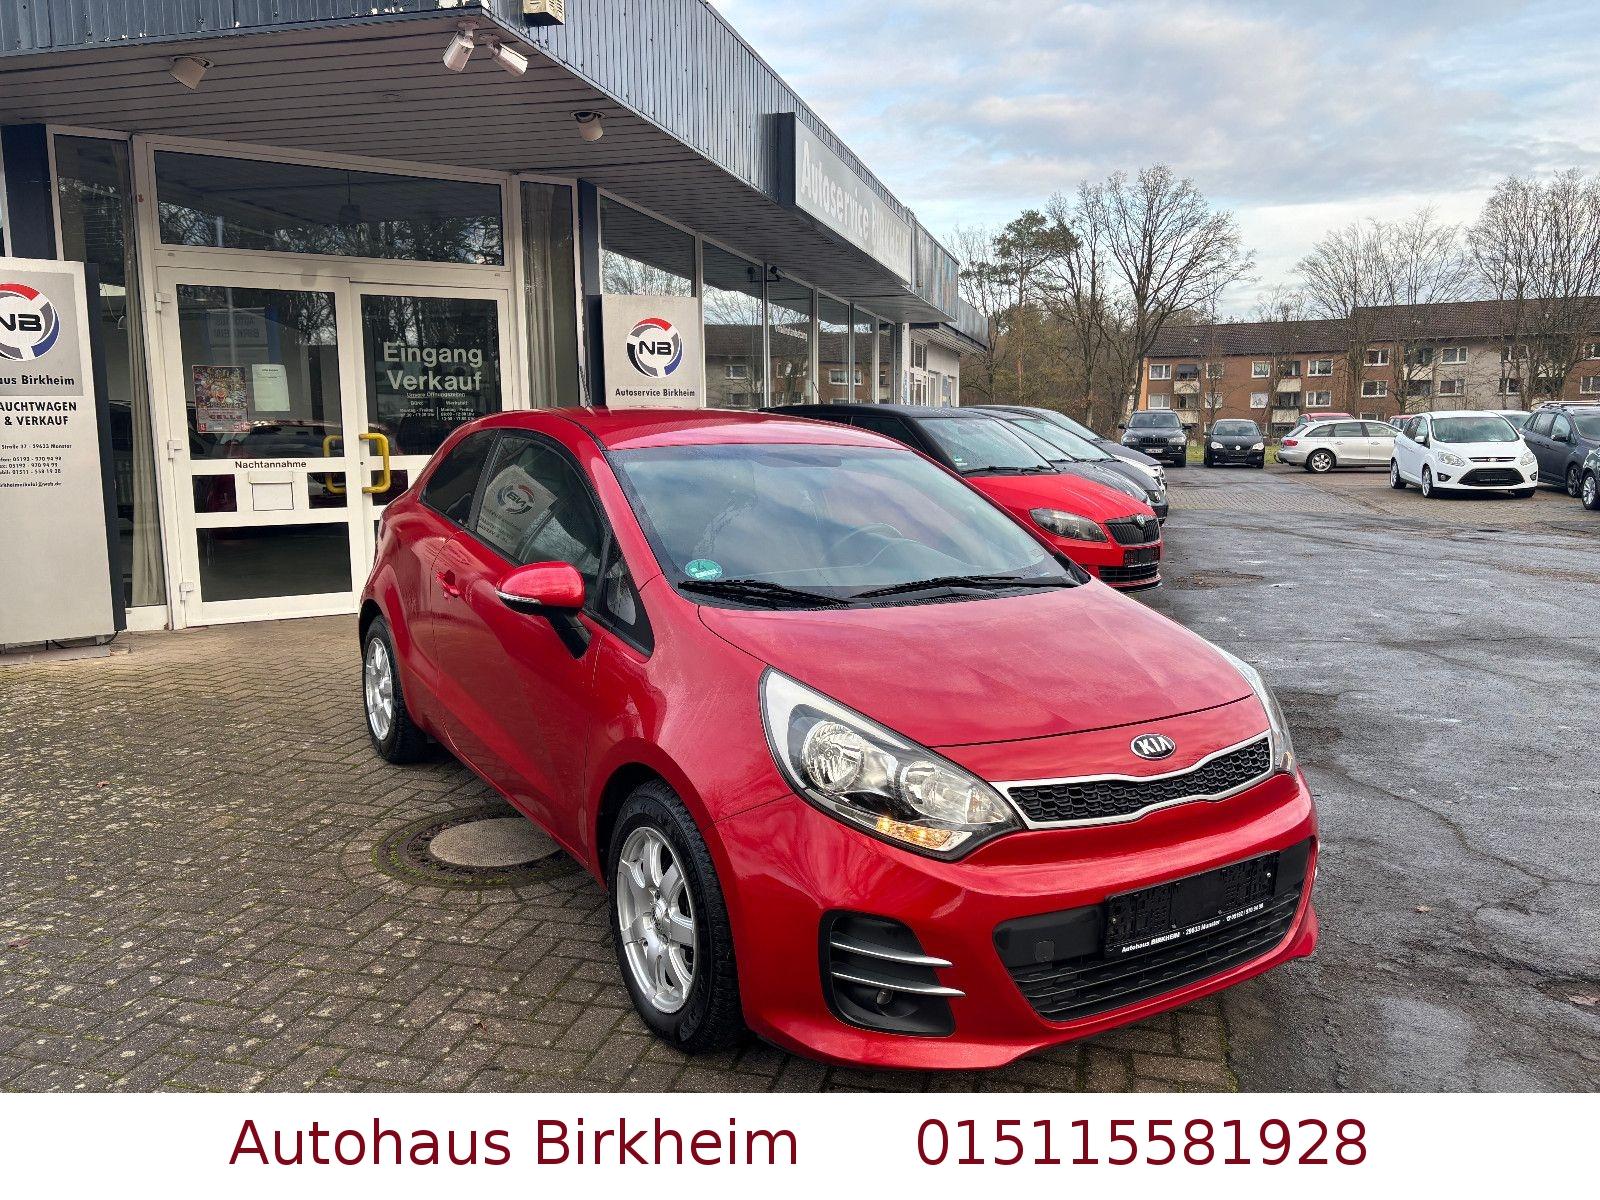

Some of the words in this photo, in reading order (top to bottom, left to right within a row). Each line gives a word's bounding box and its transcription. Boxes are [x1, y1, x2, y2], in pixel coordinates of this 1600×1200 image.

[801, 141, 869, 240] Autoservice
[383, 341, 483, 368] Eingang
[638, 340, 672, 355] NB
[21, 374, 75, 385] Birkheim
[386, 369, 482, 391] Verkauf
[615, 388, 661, 397] Autoservice
[663, 388, 695, 397] Birkheim
[4, 416, 13, 425] &
[16, 415, 69, 425] VERKAUF
[234, 460, 307, 469] Nachtannahme
[1136, 736, 1173, 755] KIA
[1121, 941, 1150, 954] Autohaus
[1150, 931, 1180, 946] BIRKHEIM
